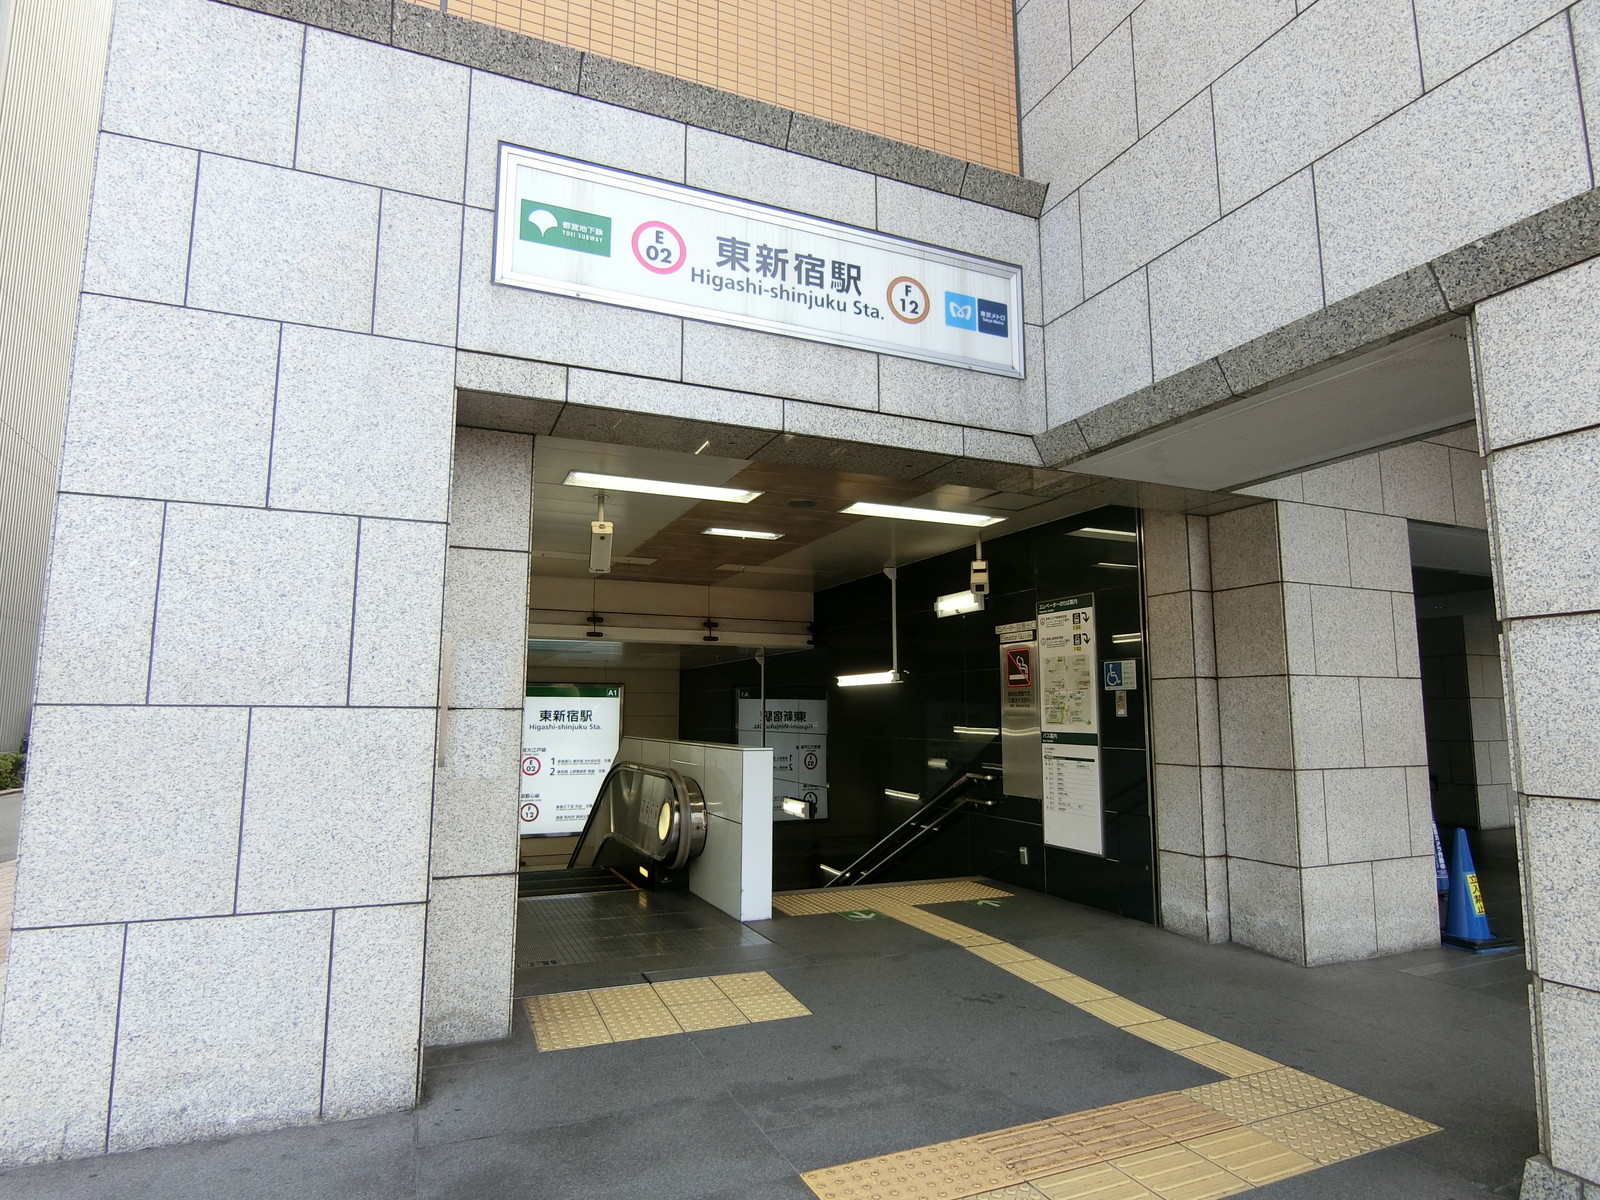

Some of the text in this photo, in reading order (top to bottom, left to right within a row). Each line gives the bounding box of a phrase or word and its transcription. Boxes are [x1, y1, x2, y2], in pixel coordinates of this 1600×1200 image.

[562, 221, 604, 236] 都営地下鉄
[562, 230, 604, 243] TOEI SUBWAY
[655, 230, 664, 245] E
[646, 246, 672, 264] 02
[715, 235, 863, 297] 東新宿駅
[691, 267, 885, 321] Higashi-shinjuku Sta.
[904, 284, 912, 297] F
[900, 298, 919, 315] 12
[607, 689, 618, 697] A1
[539, 709, 593, 723] 東新宿駅
[529, 723, 588, 731] Higashi-shinjuku
[549, 767, 556, 776] 2
[1468, 874, 1485, 914] 立入禁止
